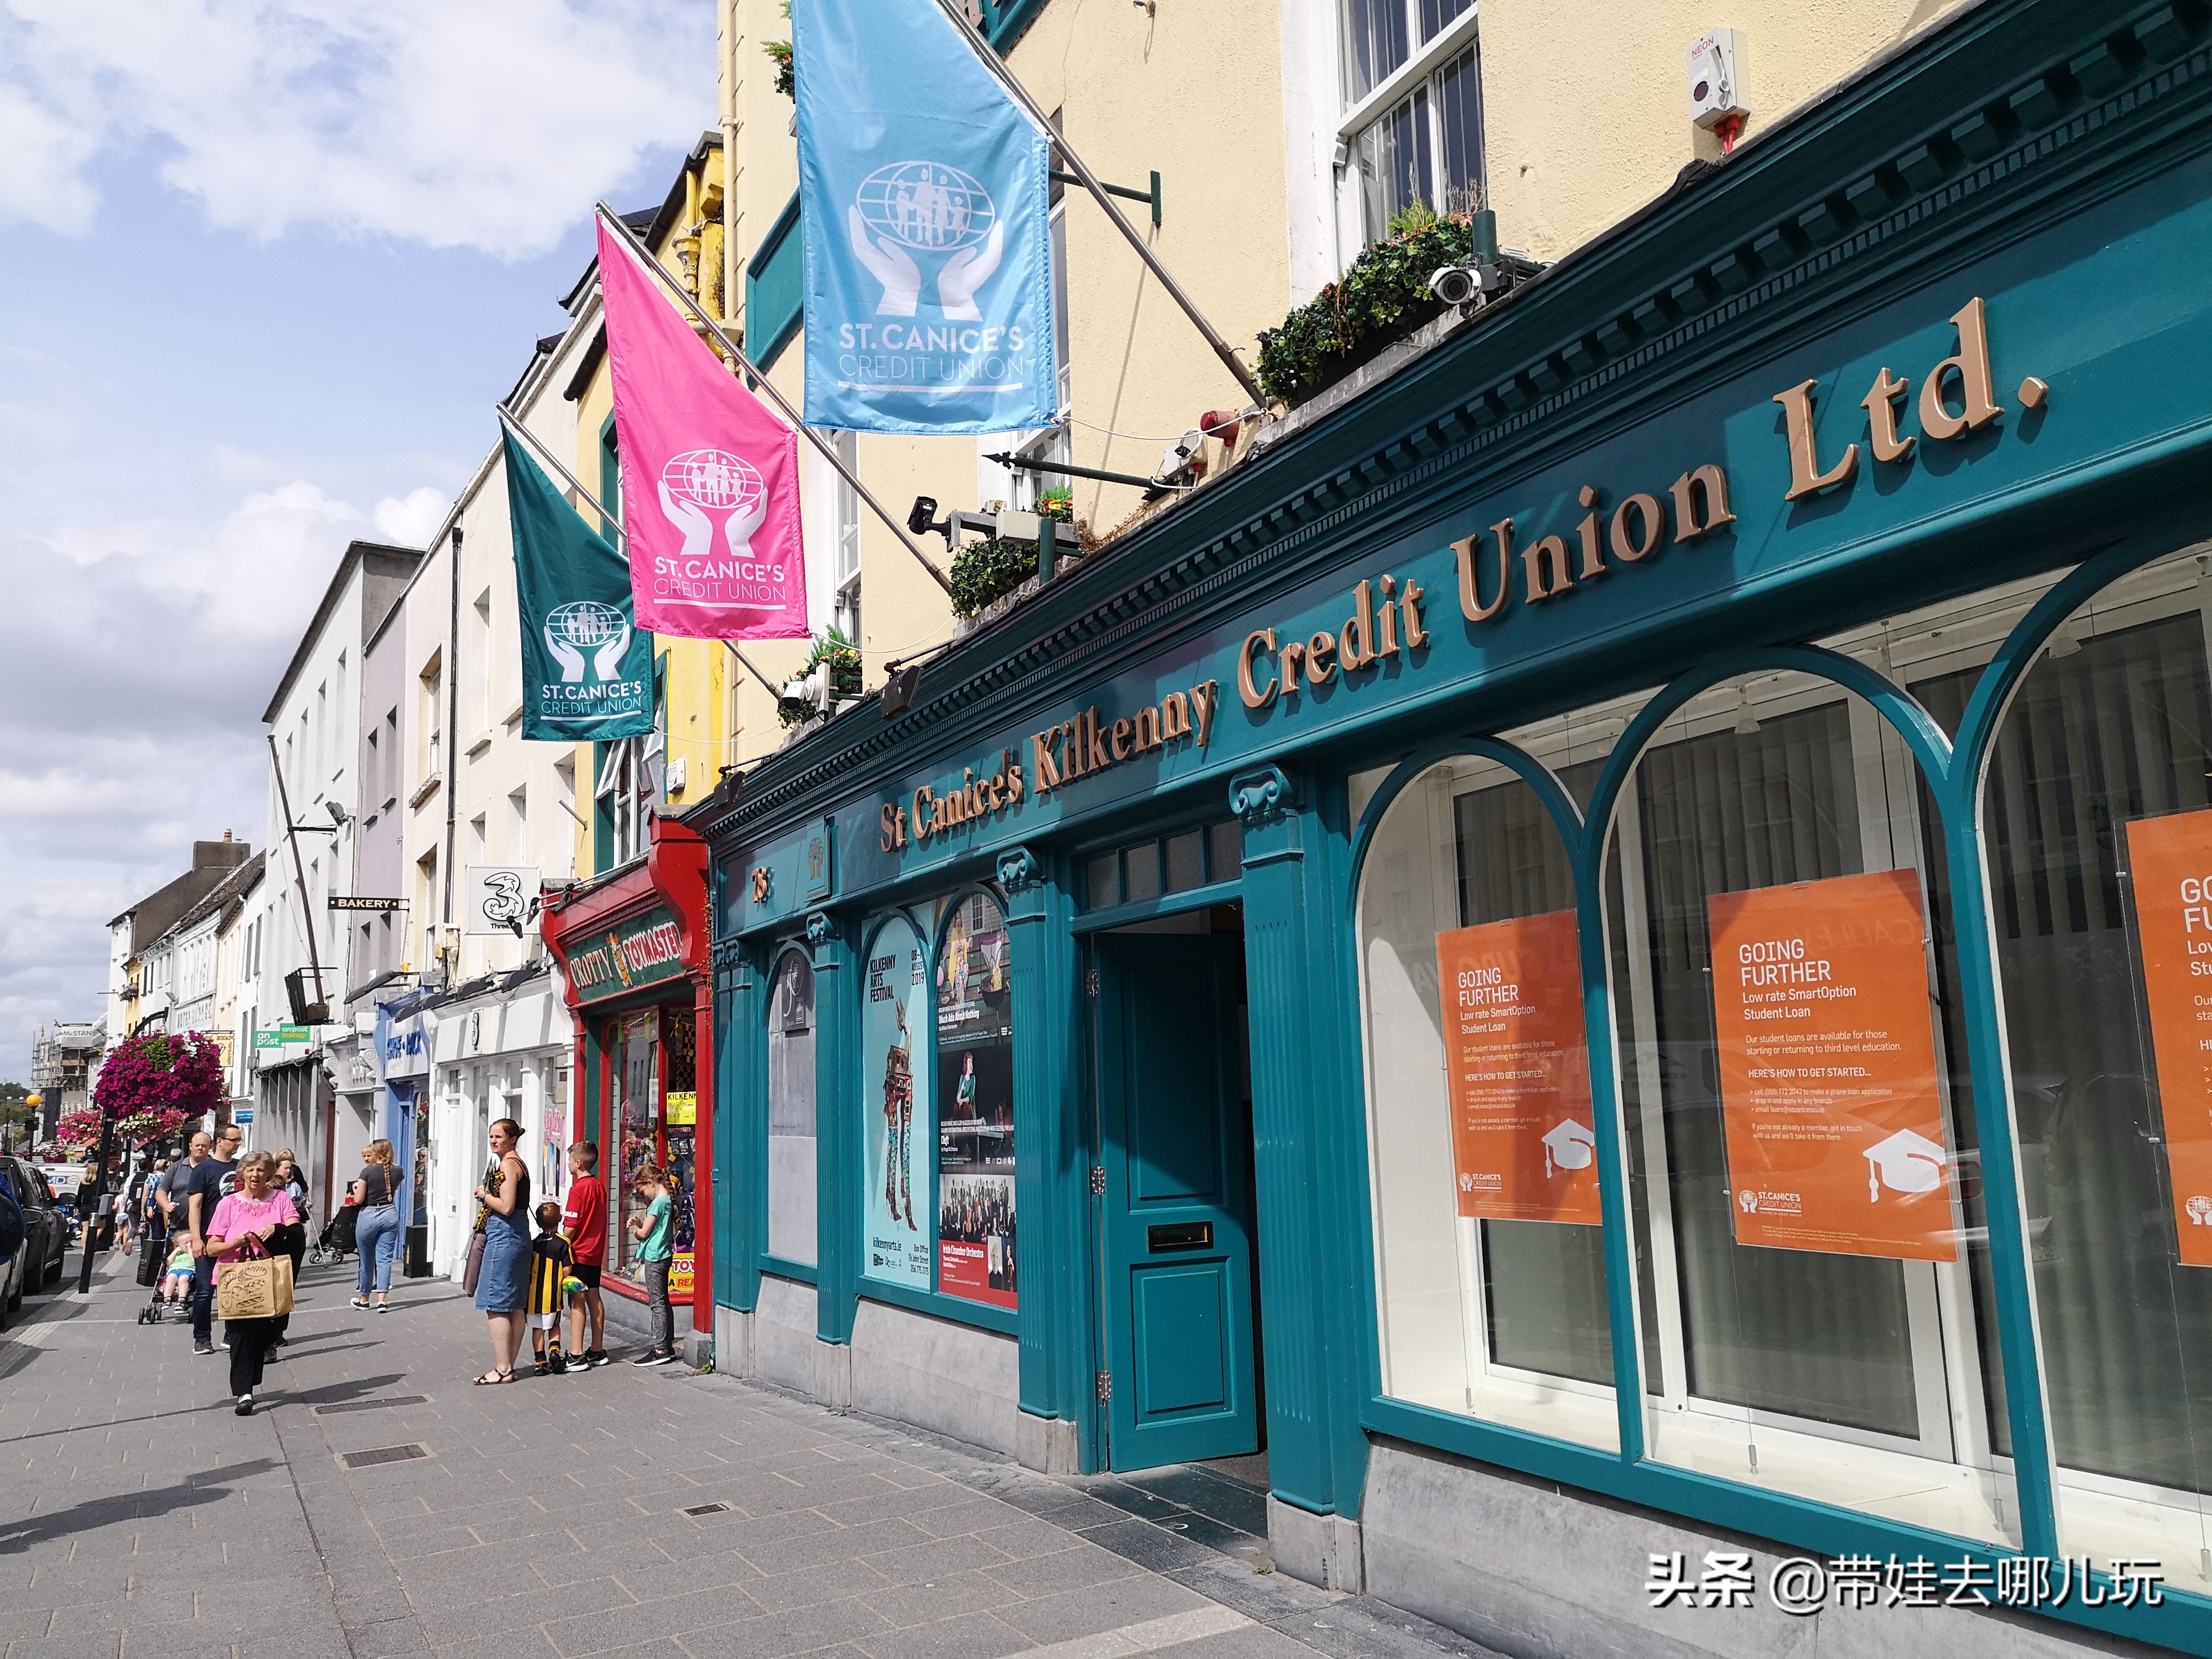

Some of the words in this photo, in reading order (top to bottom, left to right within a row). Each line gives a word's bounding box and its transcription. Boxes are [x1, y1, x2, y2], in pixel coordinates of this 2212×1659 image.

[1691, 36, 1714, 58] NEON
[839, 354, 931, 379] CREDIT
[940, 355, 1023, 381] UNION
[881, 802, 906, 852] St
[911, 749, 1023, 839] Canice's
[1031, 679, 1217, 794] Kilkenny
[1237, 574, 1430, 709] Credit
[1449, 463, 1737, 623] Union
[1773, 296, 2049, 502] Ltd.
[653, 578, 722, 598] CREDIT
[729, 583, 786, 601] UNION
[541, 701, 593, 714] CREDIT
[597, 696, 641, 714] UNION
[338, 899, 391, 908] BAKERY
[483, 871, 525, 921] 3
[570, 946, 613, 988] CROTTY
[622, 921, 683, 973] TOYMASTER
[1739, 938, 1804, 964] GOING
[870, 954, 896, 974] KILKENNY
[870, 972, 883, 988] ARTS
[912, 972, 924, 986] 2019
[1458, 967, 1501, 988] GOING
[1741, 960, 1832, 987] FURTHER
[870, 985, 894, 1003] FESTIVAL
[1459, 984, 1519, 1007] FURTHER
[1743, 992, 1763, 1003] Low
[1765, 990, 1786, 1002] rate
[1788, 985, 1856, 1001] SmartOption
[939, 1015, 948, 1024] Much
[955, 1012, 965, 1021] About
[965, 1008, 979, 1020] Nothing
[1460, 1011, 1474, 1021] Low
[1475, 1010, 1490, 1019] rate
[1491, 1004, 1536, 1017] SmartOption
[1744, 1007, 1784, 1020] Student
[1785, 1006, 1811, 1018] Loan
[1462, 1023, 1487, 1034] Student
[1488, 1022, 1506, 1032] Loan
[257, 1037, 280, 1046] post
[1745, 1035, 1758, 1044] Our
[1759, 1034, 1784, 1043] student
[1786, 1033, 1805, 1042] loans
[1820, 1031, 1851, 1041] available
[1865, 1030, 1887, 1039] those
[1486, 1052, 1508, 1061] returning
[1746, 1046, 1772, 1056] starting
[1782, 1045, 1814, 1055] returning
[1815, 1045, 1823, 1053] to
[1824, 1044, 1841, 1052] third
[1842, 1043, 1860, 1052] level
[1862, 1042, 1902, 1051] education.
[1465, 1073, 1483, 1081] HERE'S
[1483, 1073, 1496, 1081] HOW
[1505, 1071, 1516, 1080] GET
[1748, 1069, 1776, 1078] HERE'S
[1777, 1069, 1796, 1078] HOW
[1797, 1068, 1808, 1077] TO
[1810, 1068, 1825, 1077] GET
[1830, 1089, 1847, 1097] phone
[1782, 1124, 1801, 1132] already
[1758, 1200, 1781, 1208] CREDIT
[1781, 1201, 1802, 1209] UNION
[966, 1246, 984, 1258] Orchestra
